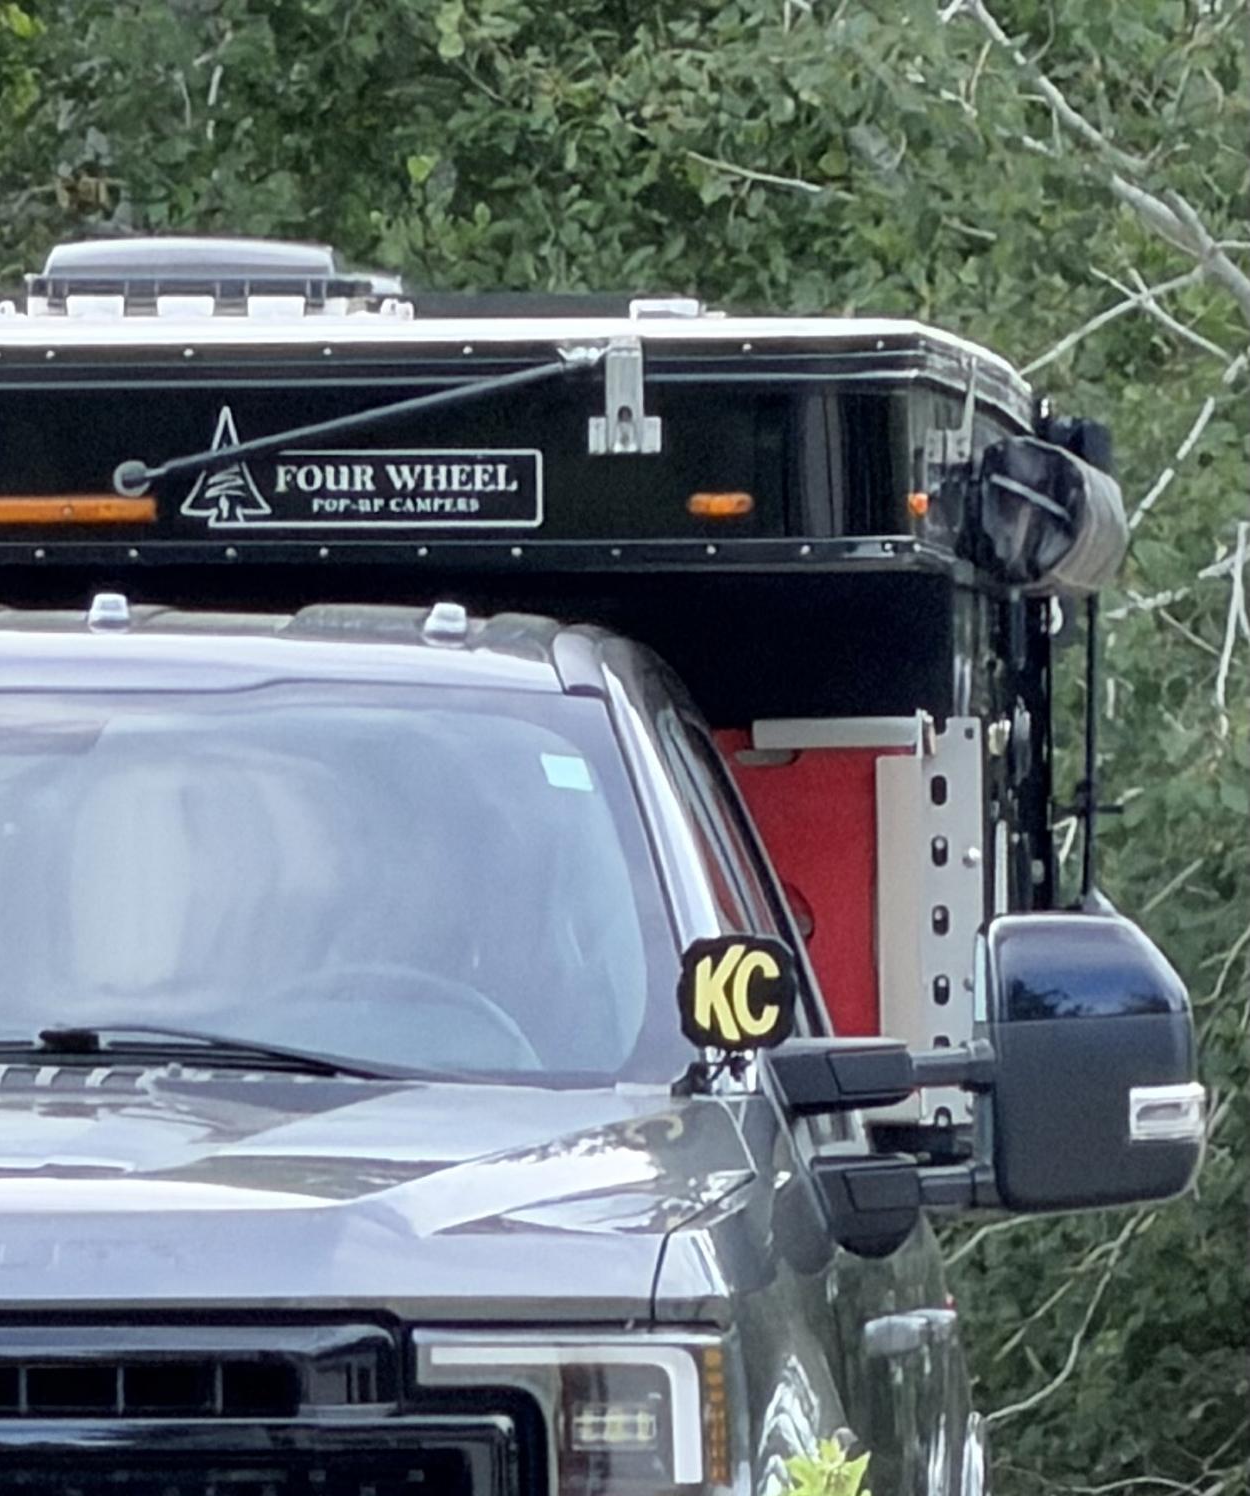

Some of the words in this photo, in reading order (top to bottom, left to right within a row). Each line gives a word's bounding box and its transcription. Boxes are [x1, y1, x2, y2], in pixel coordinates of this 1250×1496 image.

[275, 464, 376, 493] FOUR
[384, 463, 519, 492] WHEEL
[389, 497, 481, 513] CAMPERS
[693, 943, 781, 1042] KC
